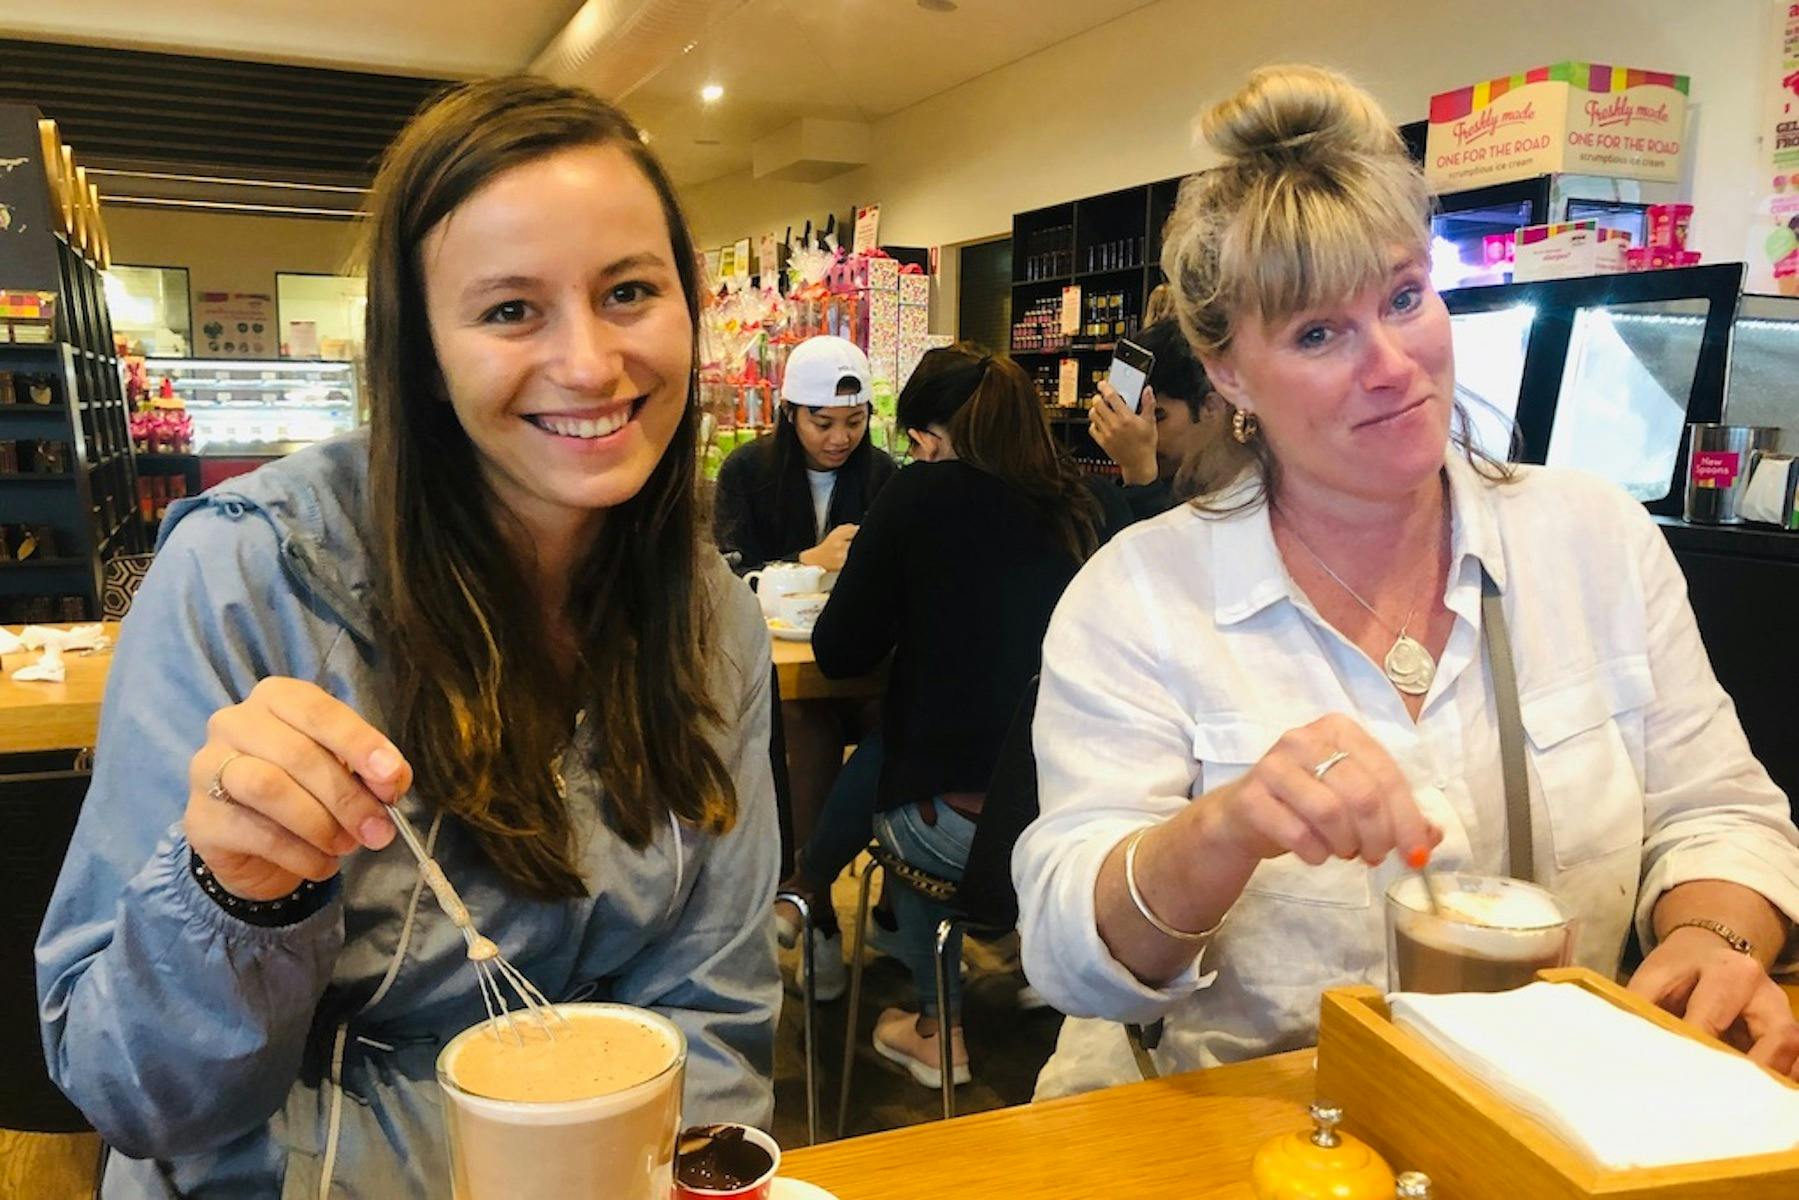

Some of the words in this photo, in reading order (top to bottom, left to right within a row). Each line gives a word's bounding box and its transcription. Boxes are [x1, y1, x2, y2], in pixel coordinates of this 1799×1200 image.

[1585, 96, 1633, 127] Freshly
[1637, 103, 1668, 122] made
[1453, 106, 1497, 146] Freshly
[1502, 101, 1536, 121] made
[1437, 152, 1460, 169] ONE
[1463, 148, 1487, 164] FOR
[1490, 142, 1513, 158] THE
[1514, 135, 1550, 154] ROAD
[1568, 131, 1594, 146] ONE
[1597, 134, 1620, 148] FOR
[1624, 136, 1645, 151] THE
[1647, 139, 1679, 155] ROAD
[1448, 164, 1494, 179] scrumptious
[1496, 162, 1506, 171] ice
[1508, 158, 1534, 169] cream
[1580, 152, 1627, 165] scrumptious
[1630, 156, 1641, 166] ice
[1642, 158, 1665, 168] cream
[1695, 464, 1729, 476] Spoons
[1700, 456, 1723, 466] New
